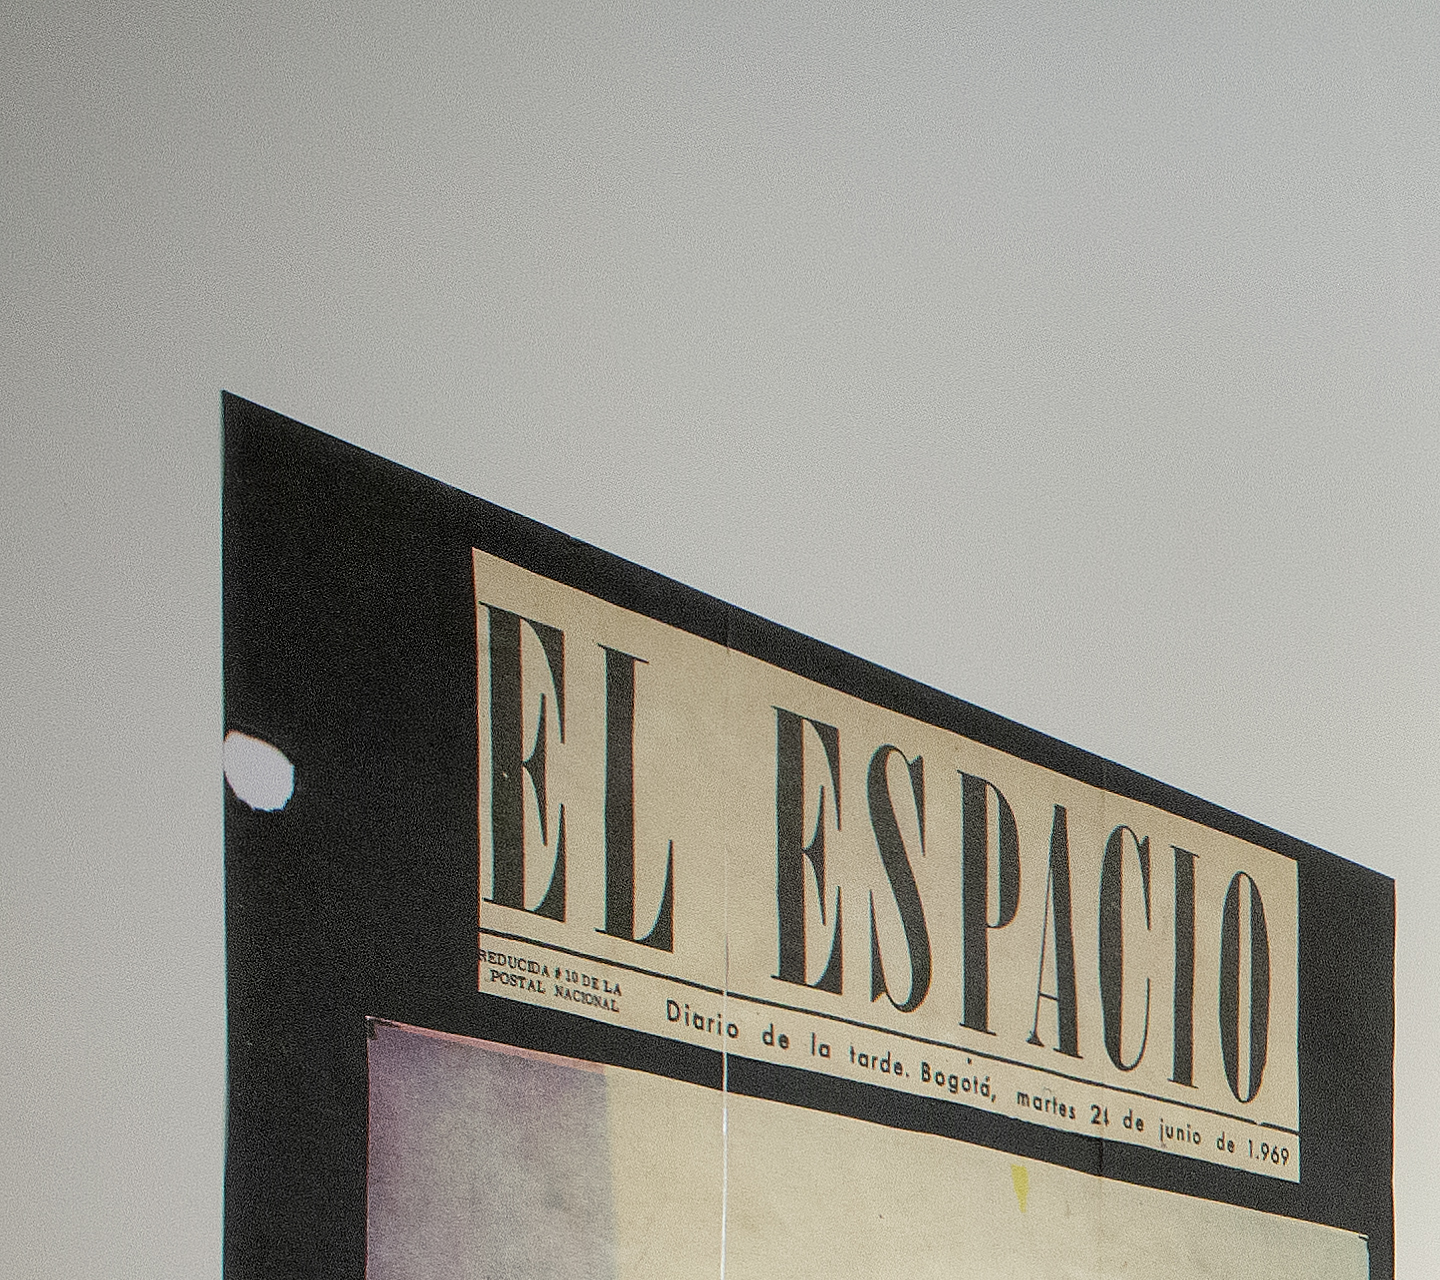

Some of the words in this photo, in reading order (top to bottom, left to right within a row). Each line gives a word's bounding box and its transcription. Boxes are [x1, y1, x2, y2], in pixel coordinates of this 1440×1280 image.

[478, 601, 675, 953] EL
[769, 704, 1271, 1105] ESPACIO
[490, 969, 546, 994] POSTAL
[553, 984, 620, 1013] NACIONAL
[581, 973, 599, 990] DE
[603, 979, 622, 996] LA
[666, 998, 740, 1039] Diario
[762, 1023, 790, 1050] de
[810, 1032, 831, 1058] la
[849, 1045, 910, 1078] tarde.
[920, 1061, 997, 1103] Bogotá,
[1016, 1089, 1077, 1120] martes
[1123, 1108, 1145, 1132] de
[1159, 1118, 1202, 1145] junio
[1216, 1131, 1236, 1154] de
[1248, 1138, 1290, 1167] 1.969
